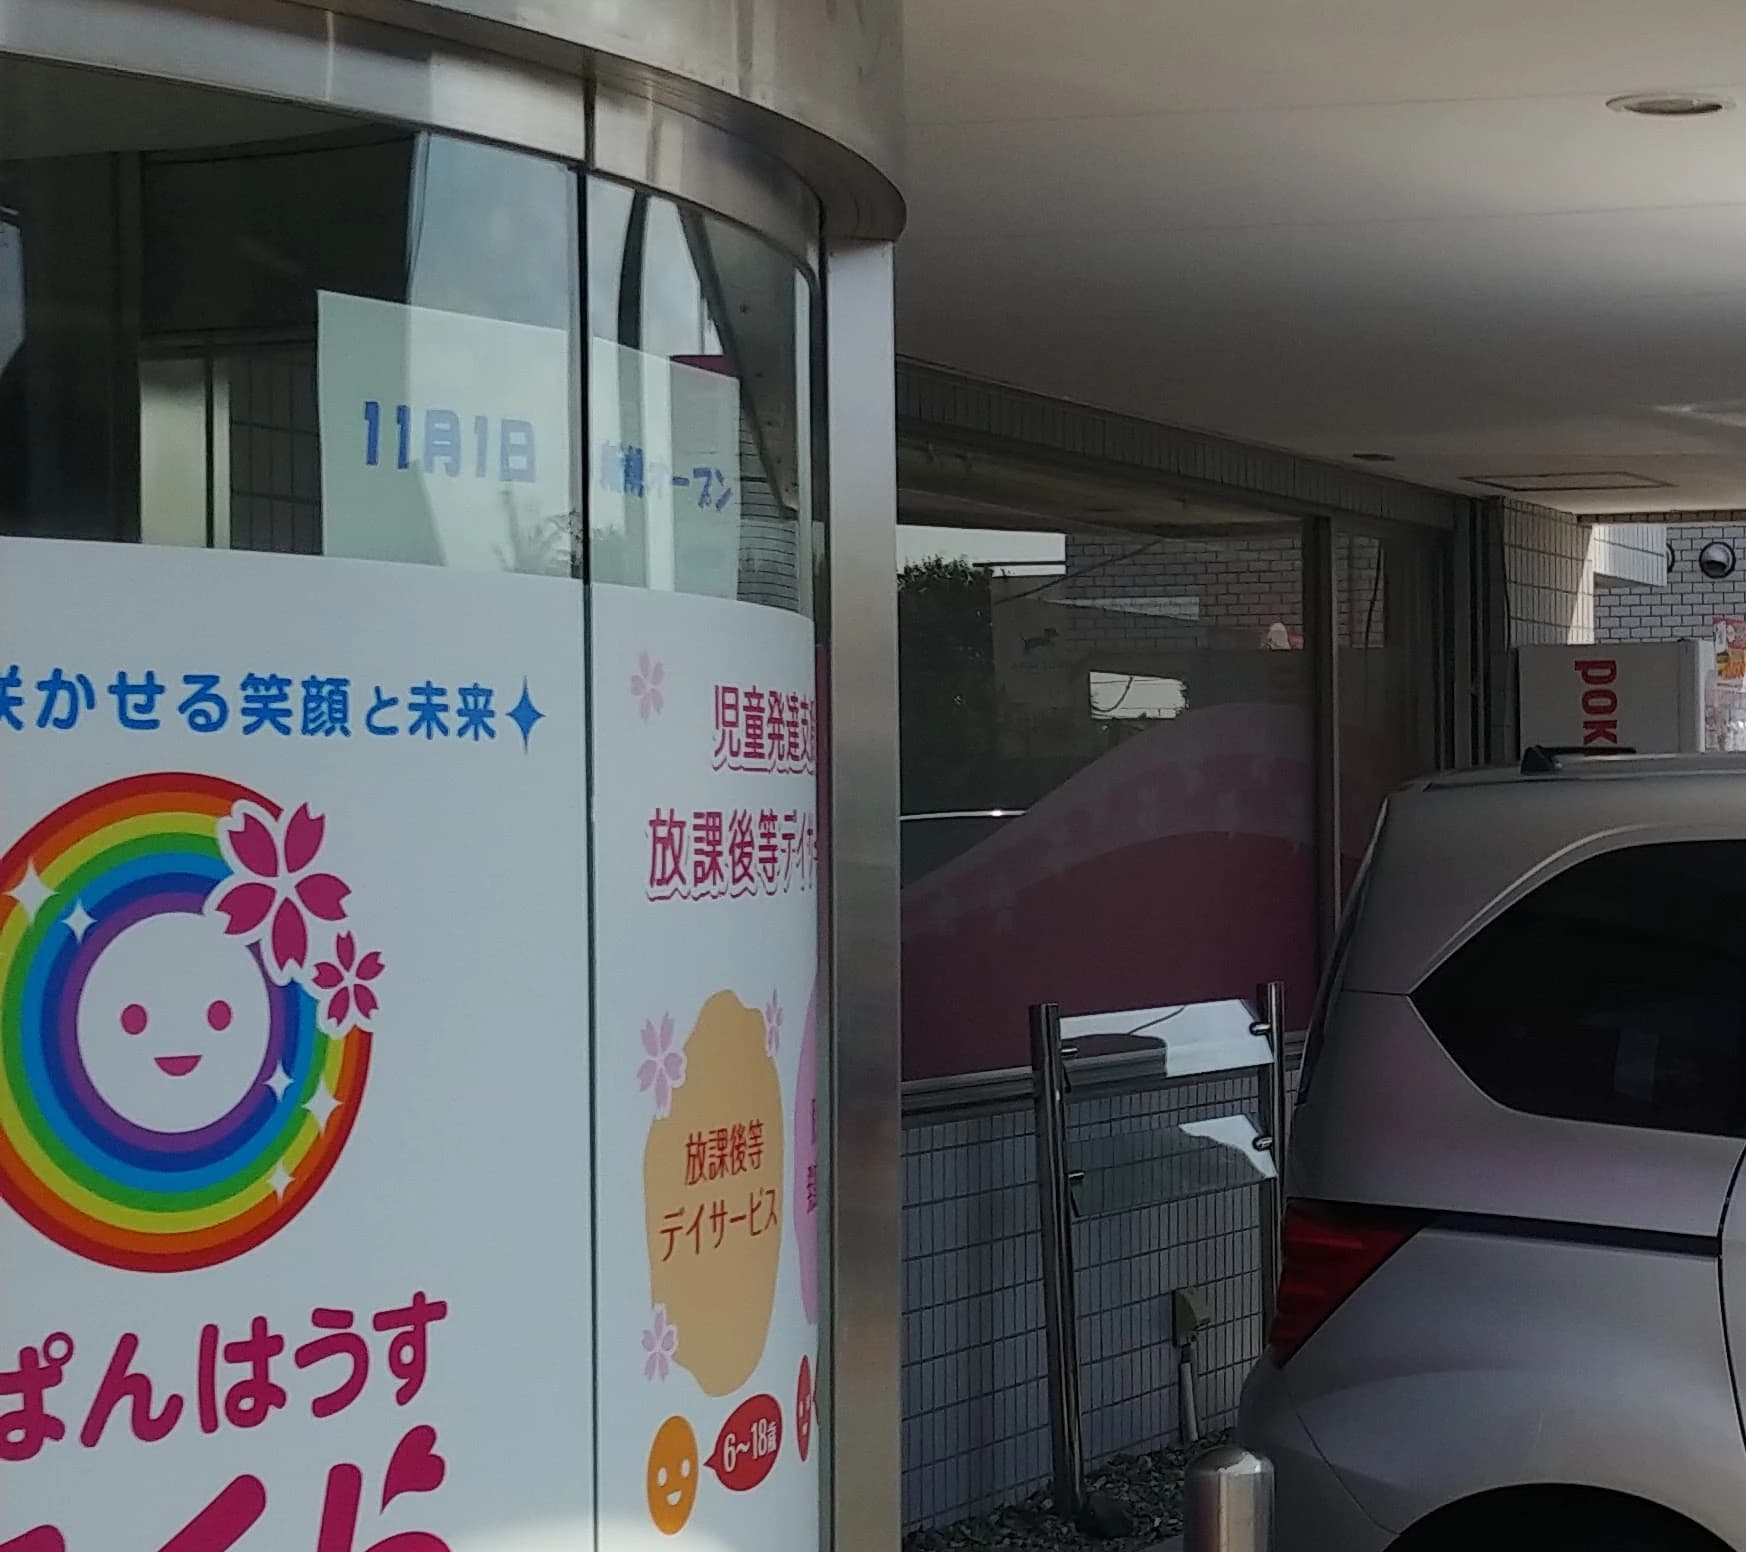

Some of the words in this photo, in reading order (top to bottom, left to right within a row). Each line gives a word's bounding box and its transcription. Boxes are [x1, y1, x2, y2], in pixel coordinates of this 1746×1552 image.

[364, 400, 537, 483] 11月1日
[685, 1119, 764, 1186] 放課後等
[658, 1189, 778, 1262] デイサービス
